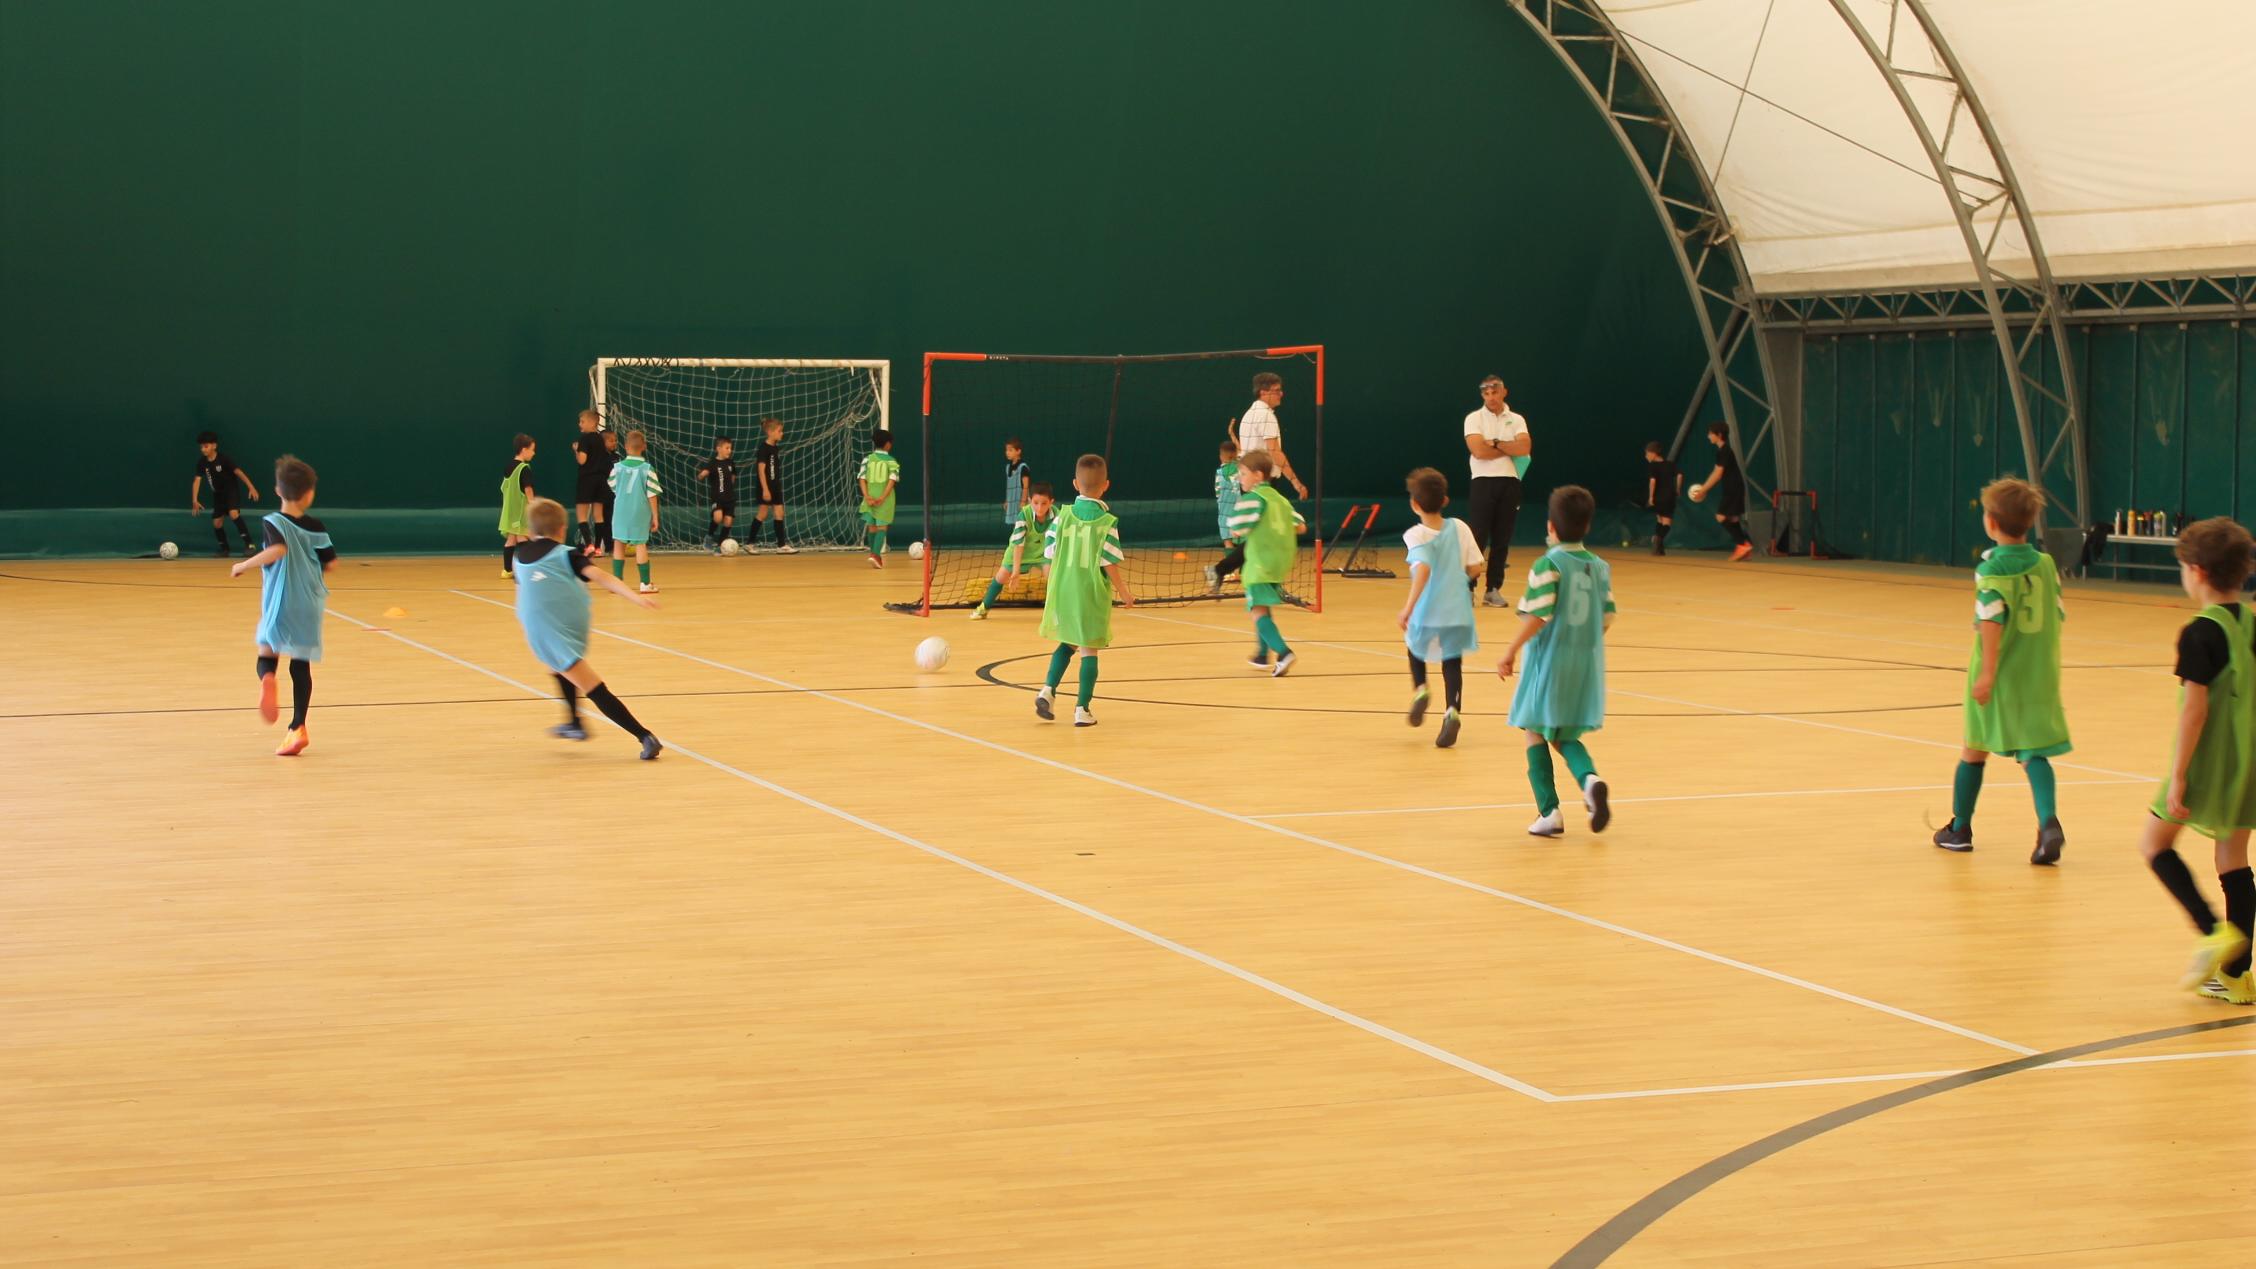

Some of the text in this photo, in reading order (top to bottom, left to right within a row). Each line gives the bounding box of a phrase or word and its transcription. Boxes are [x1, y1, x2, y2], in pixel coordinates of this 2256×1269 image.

[869, 460, 887, 483] 10
[1063, 524, 1091, 568] 11
[1567, 571, 1592, 626] 6
[2016, 574, 2043, 634] 3
